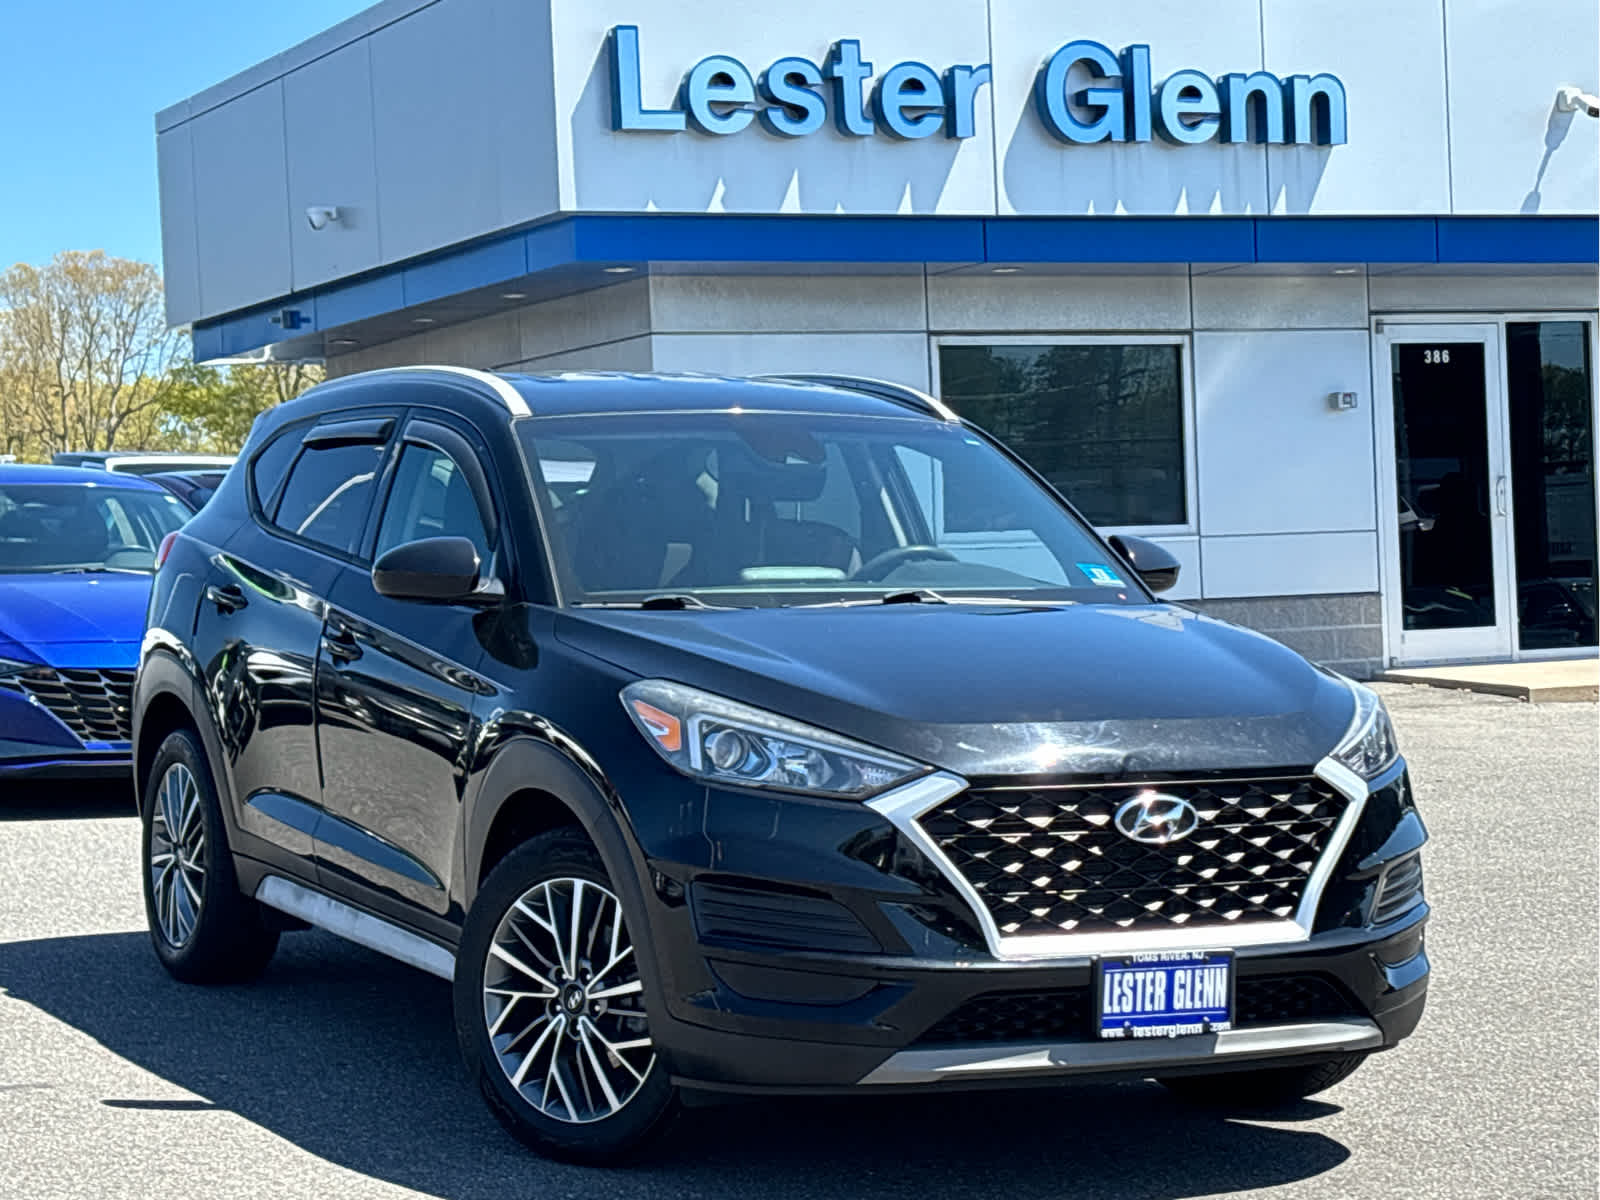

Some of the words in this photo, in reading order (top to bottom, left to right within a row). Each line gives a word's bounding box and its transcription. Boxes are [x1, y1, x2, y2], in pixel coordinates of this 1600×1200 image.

[610, 25, 990, 139] Lester
[1038, 40, 1348, 145] Glenn
[1423, 349, 1450, 364] 386
[1103, 970, 1167, 1014] LESTER
[1173, 967, 1228, 1010] GLENN
[1133, 1023, 1204, 1038] lesterglenn
